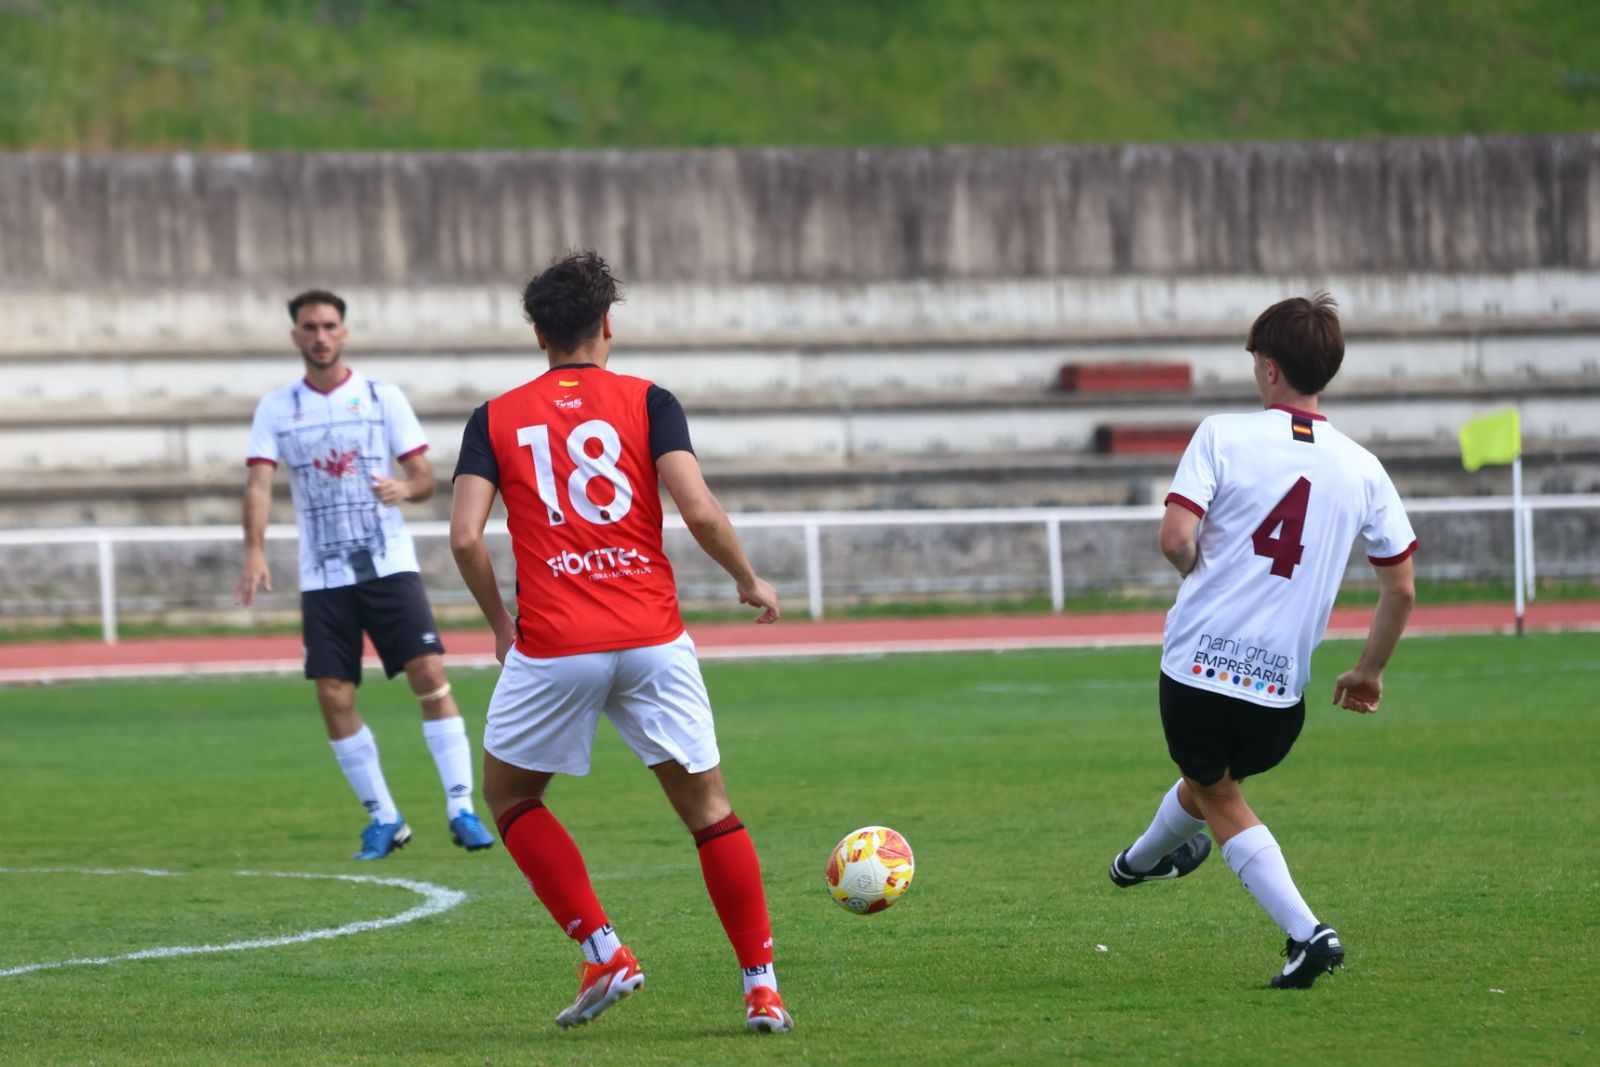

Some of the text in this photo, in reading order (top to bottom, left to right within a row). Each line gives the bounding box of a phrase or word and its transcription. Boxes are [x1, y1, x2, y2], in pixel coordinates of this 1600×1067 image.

[516, 419, 634, 527] 18
[1251, 475, 1312, 580] 4
[1193, 651, 1290, 686] EMPRESARIAL
[1199, 633, 1242, 656] nani
